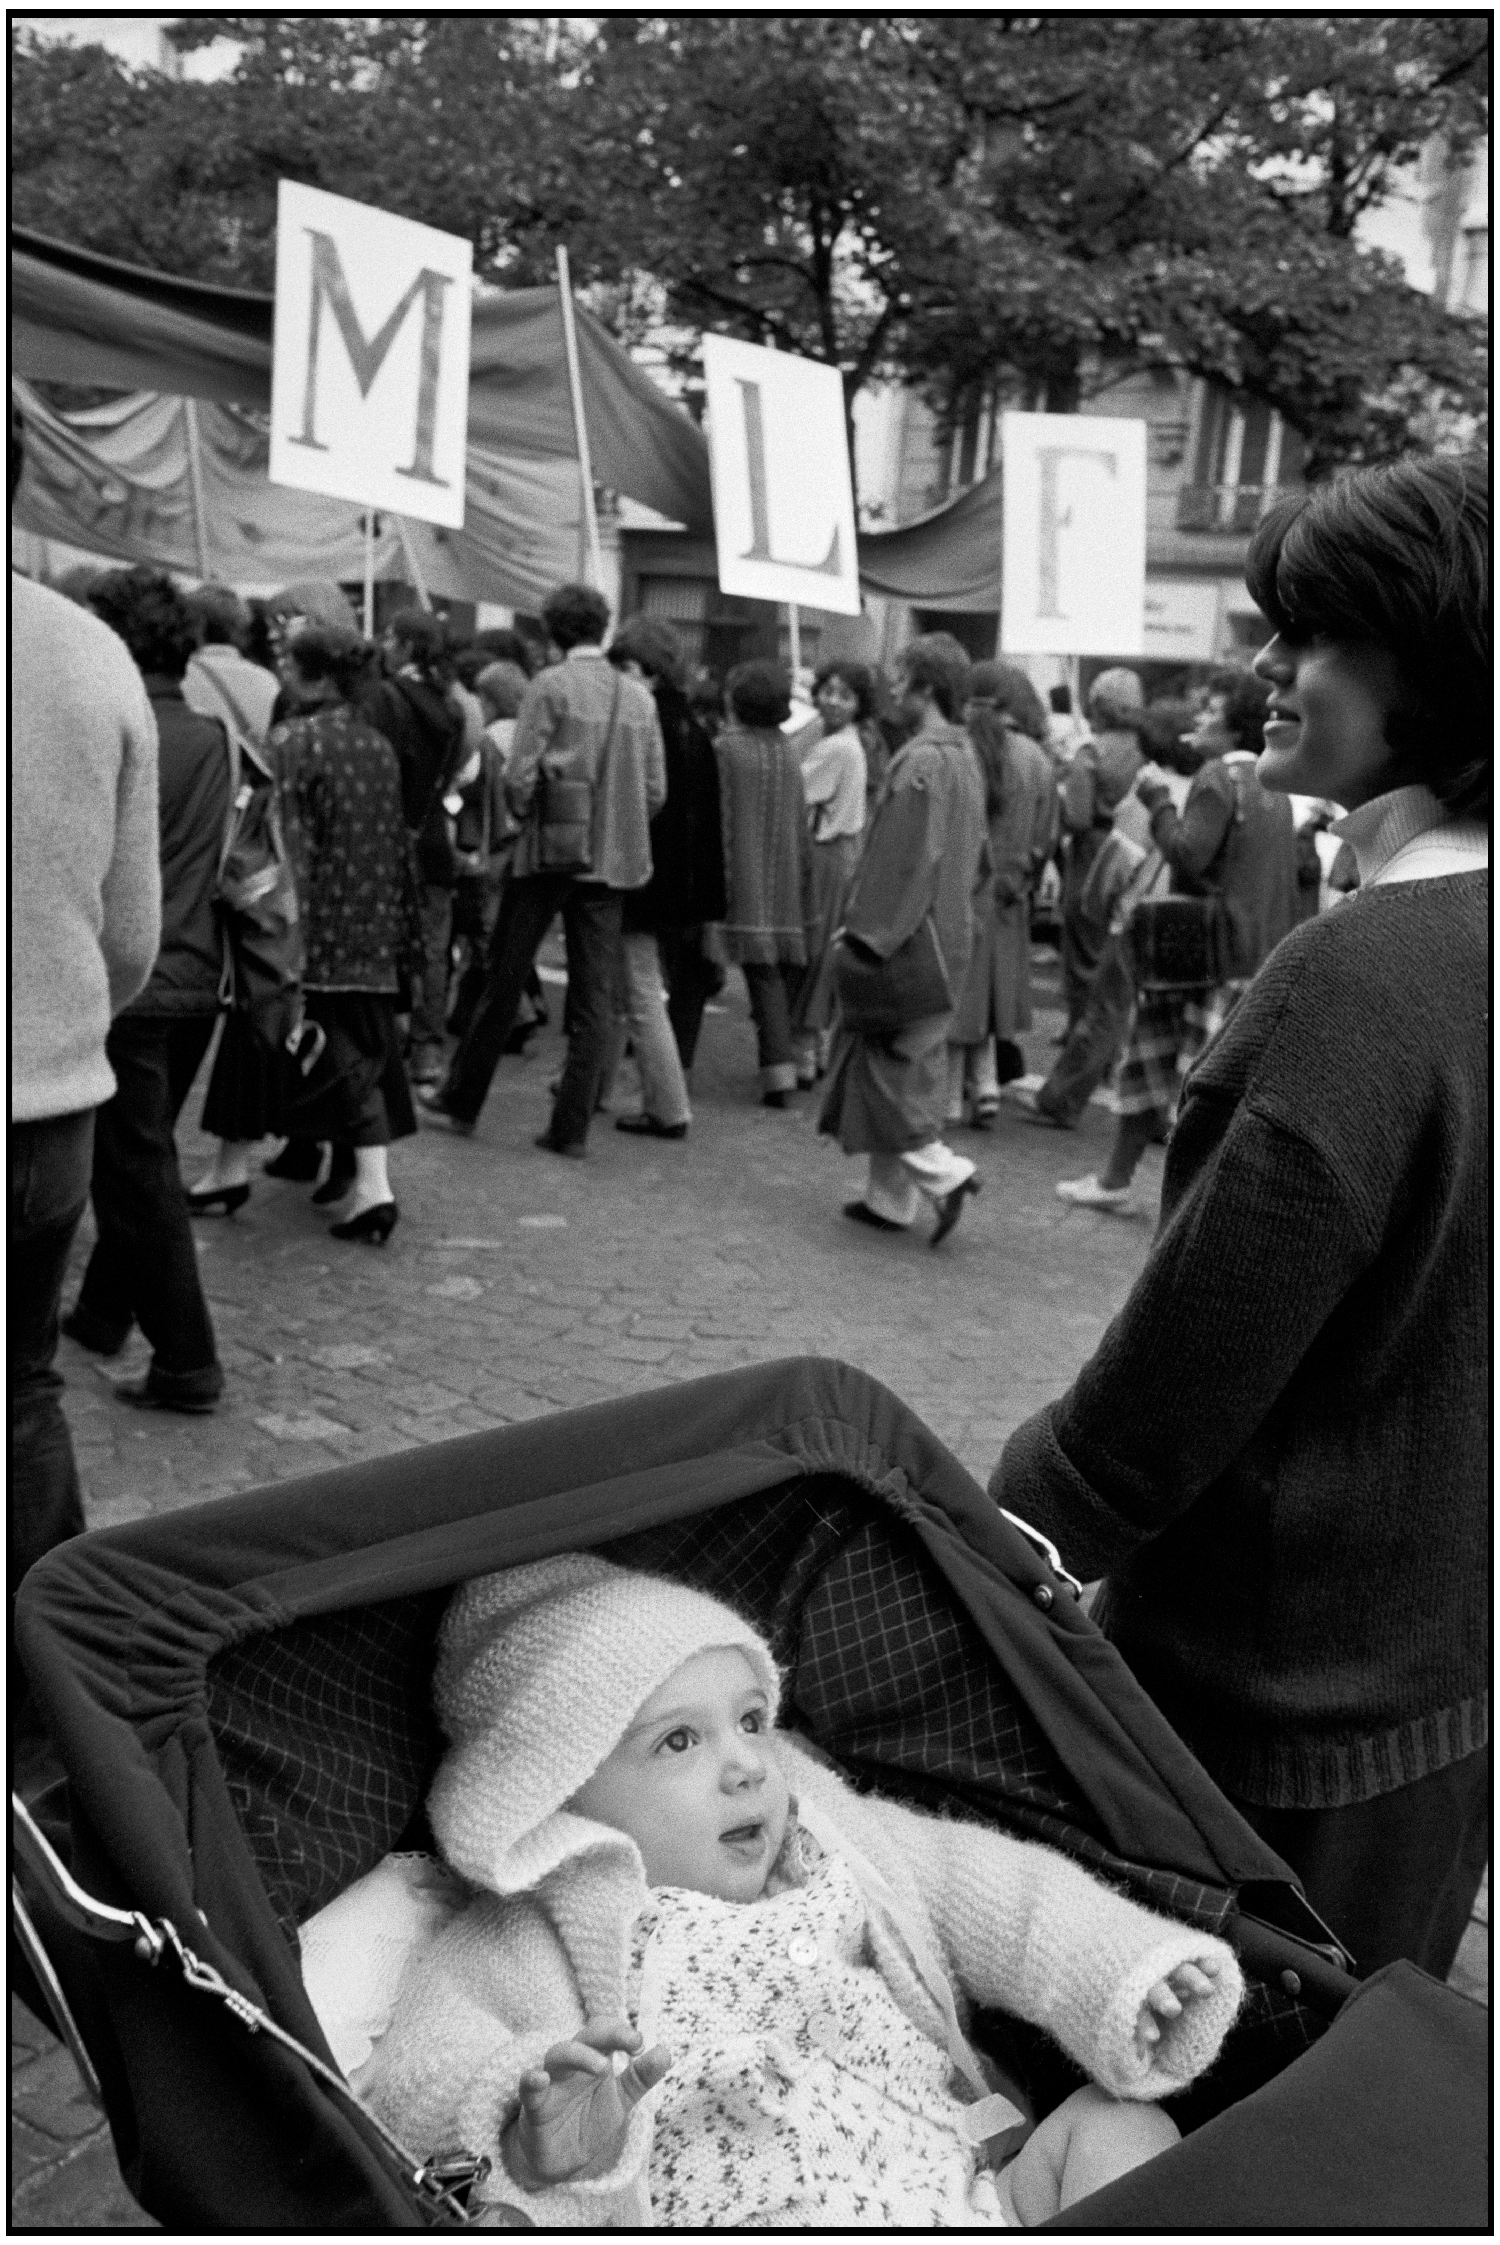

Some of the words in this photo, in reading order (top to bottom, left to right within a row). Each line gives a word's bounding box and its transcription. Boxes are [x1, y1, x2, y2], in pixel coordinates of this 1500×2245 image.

[288, 227, 454, 488] M
[734, 378, 842, 576] L
[1036, 447, 1118, 620] F
